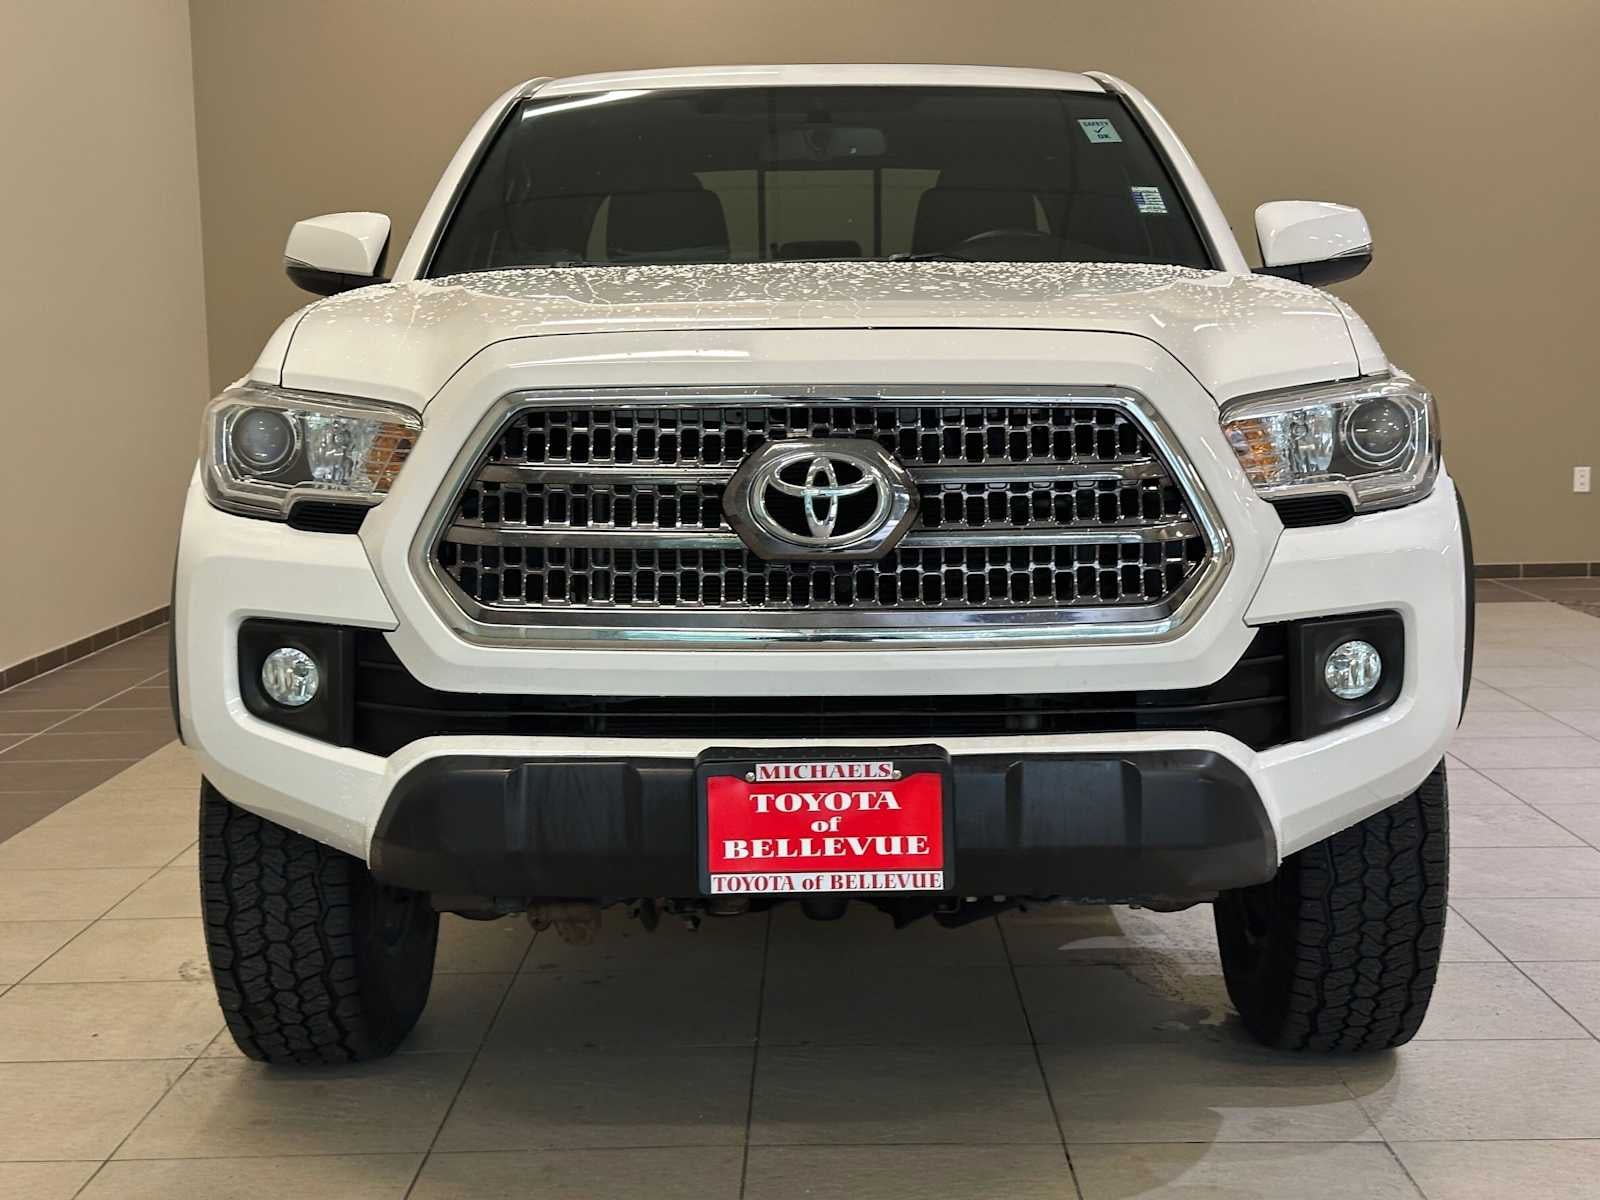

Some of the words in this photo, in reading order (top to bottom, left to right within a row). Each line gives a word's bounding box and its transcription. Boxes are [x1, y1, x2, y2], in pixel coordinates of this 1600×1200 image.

[759, 763, 891, 779] MICHAELS
[749, 791, 901, 812] TOYOTA
[811, 816, 842, 833] of
[723, 836, 930, 859] BELLEVUE
[713, 875, 795, 892] TOYOTA
[802, 875, 824, 890] of
[831, 873, 941, 890] BELLEVUE
